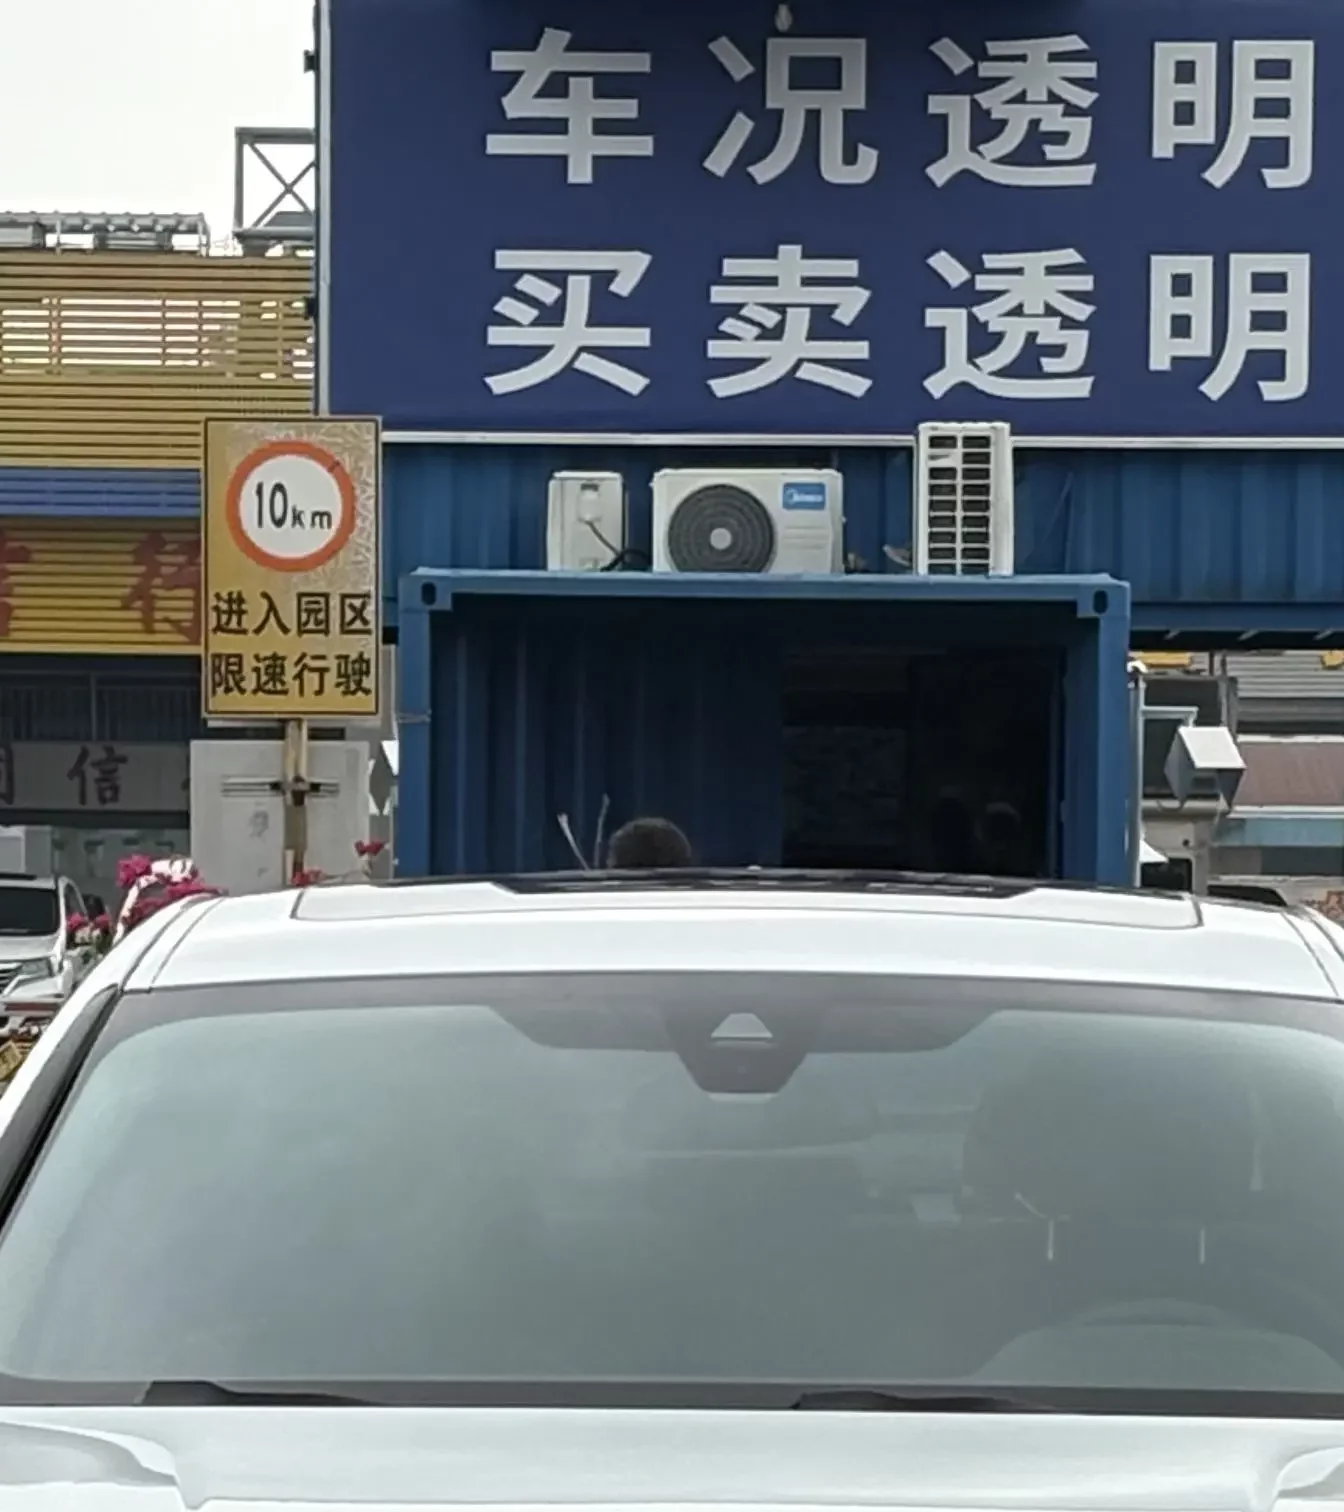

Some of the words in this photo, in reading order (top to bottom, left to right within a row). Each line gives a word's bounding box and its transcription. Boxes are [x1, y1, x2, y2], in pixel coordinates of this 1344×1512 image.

[485, 26, 1315, 189] 车况透明
[484, 244, 1313, 400] 买卖透明
[211, 590, 374, 638] 进入园区
[211, 653, 373, 698] 限速行驶
